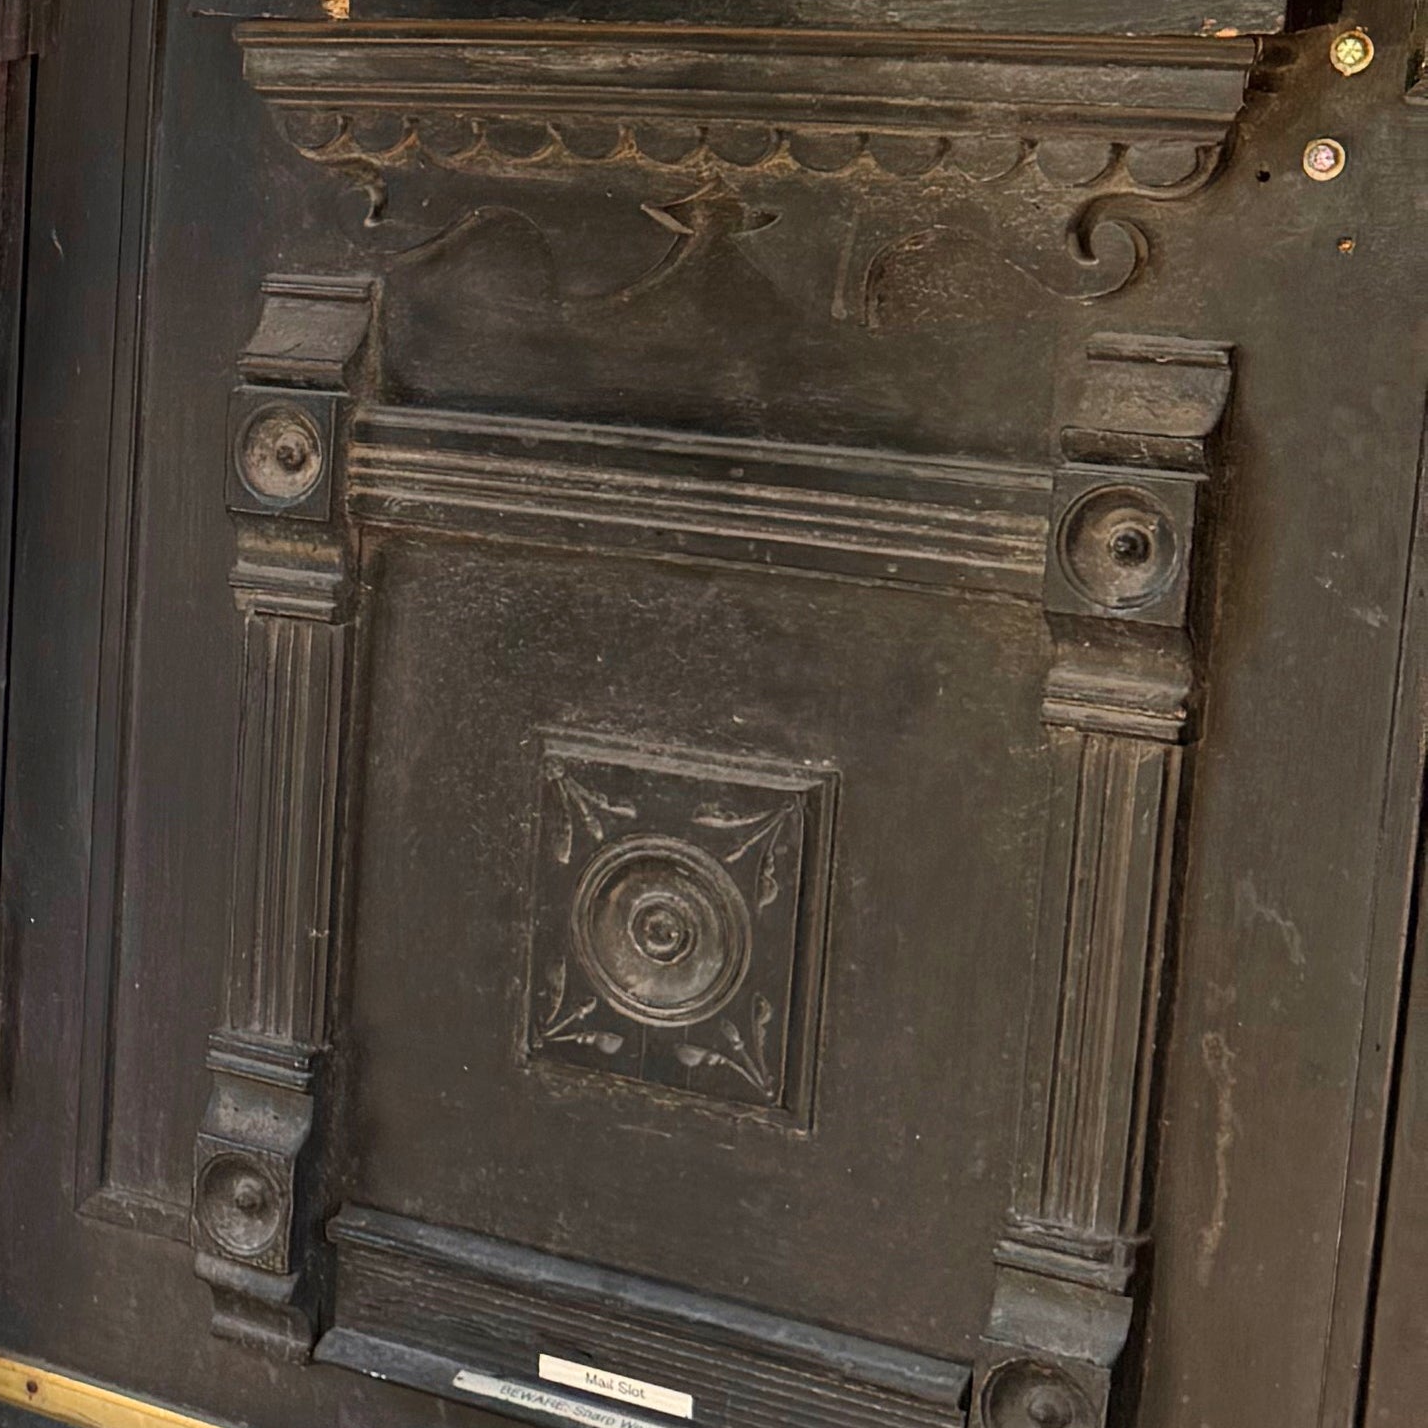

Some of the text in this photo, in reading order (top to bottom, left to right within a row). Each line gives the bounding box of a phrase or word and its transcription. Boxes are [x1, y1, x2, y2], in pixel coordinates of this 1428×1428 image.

[499, 1384, 568, 1412] BEWARE:
[585, 1372, 646, 1399] Mail Slot
